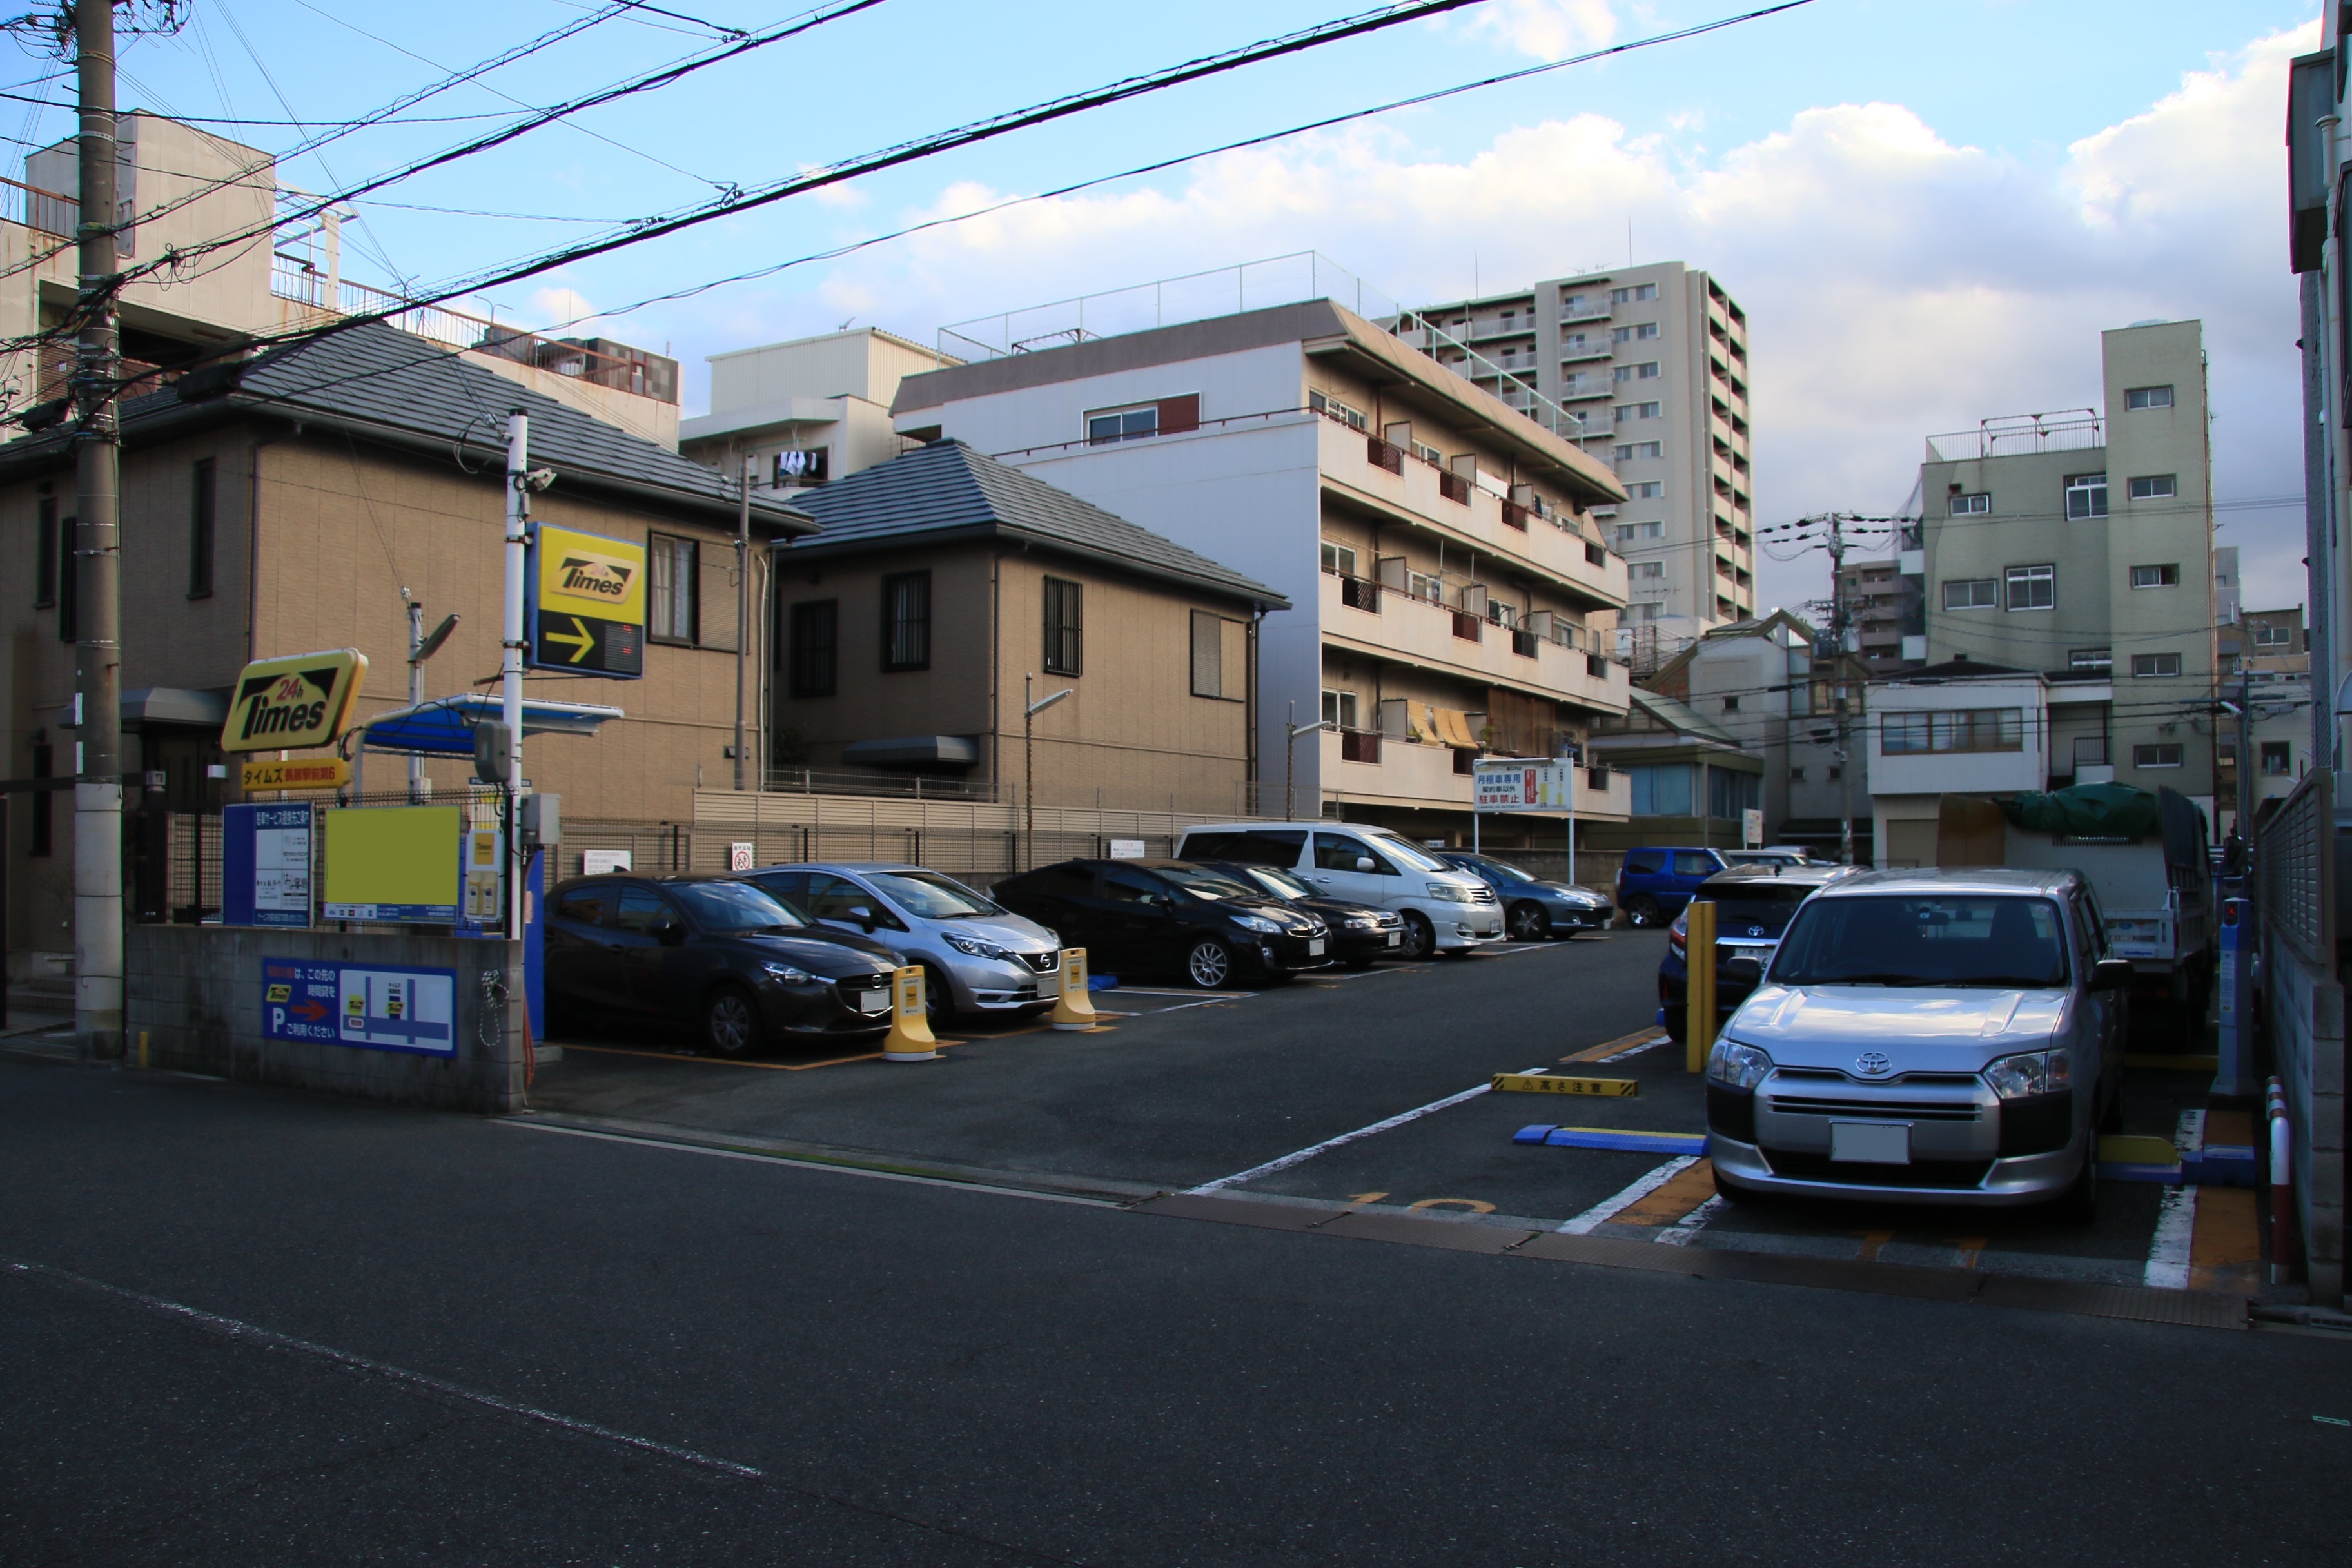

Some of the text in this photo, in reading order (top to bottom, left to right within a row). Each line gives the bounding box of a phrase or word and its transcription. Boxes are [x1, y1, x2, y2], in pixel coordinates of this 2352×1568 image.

[562, 567, 623, 595] Times
[277, 678, 304, 701] 24h
[241, 694, 326, 740] Times
[244, 769, 282, 785] タイムズ
[1478, 774, 1521, 784] 月極車専用
[1479, 794, 1520, 804] 駐車禁止
[273, 1007, 285, 1033] P
[287, 1023, 335, 1039] ご利用ください
[1540, 1079, 1602, 1093] 高さ注意
